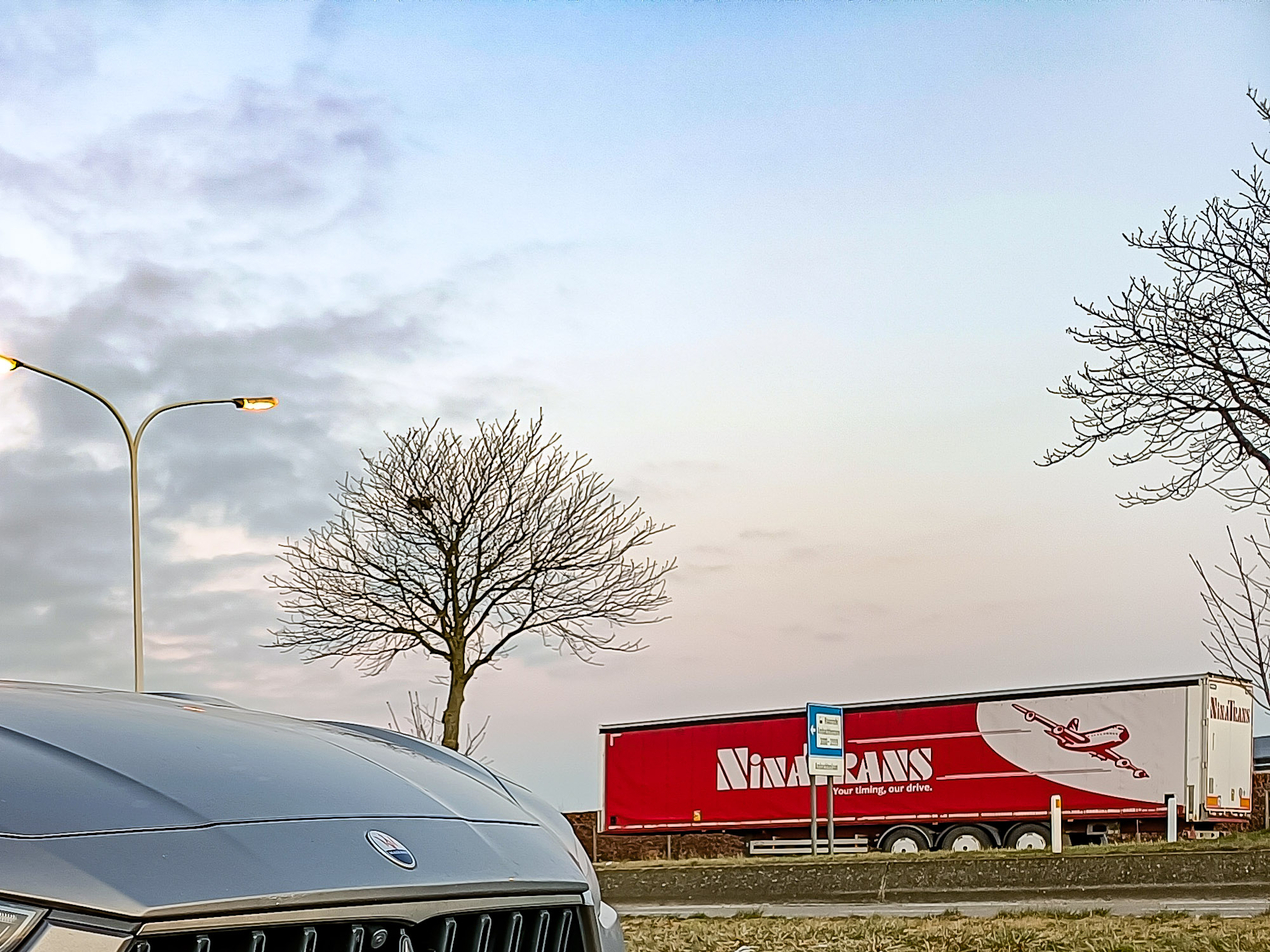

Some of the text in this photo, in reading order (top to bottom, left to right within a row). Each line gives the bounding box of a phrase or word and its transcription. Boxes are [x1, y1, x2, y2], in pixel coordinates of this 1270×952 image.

[833, 783, 933, 796] Your timing, our drive.
